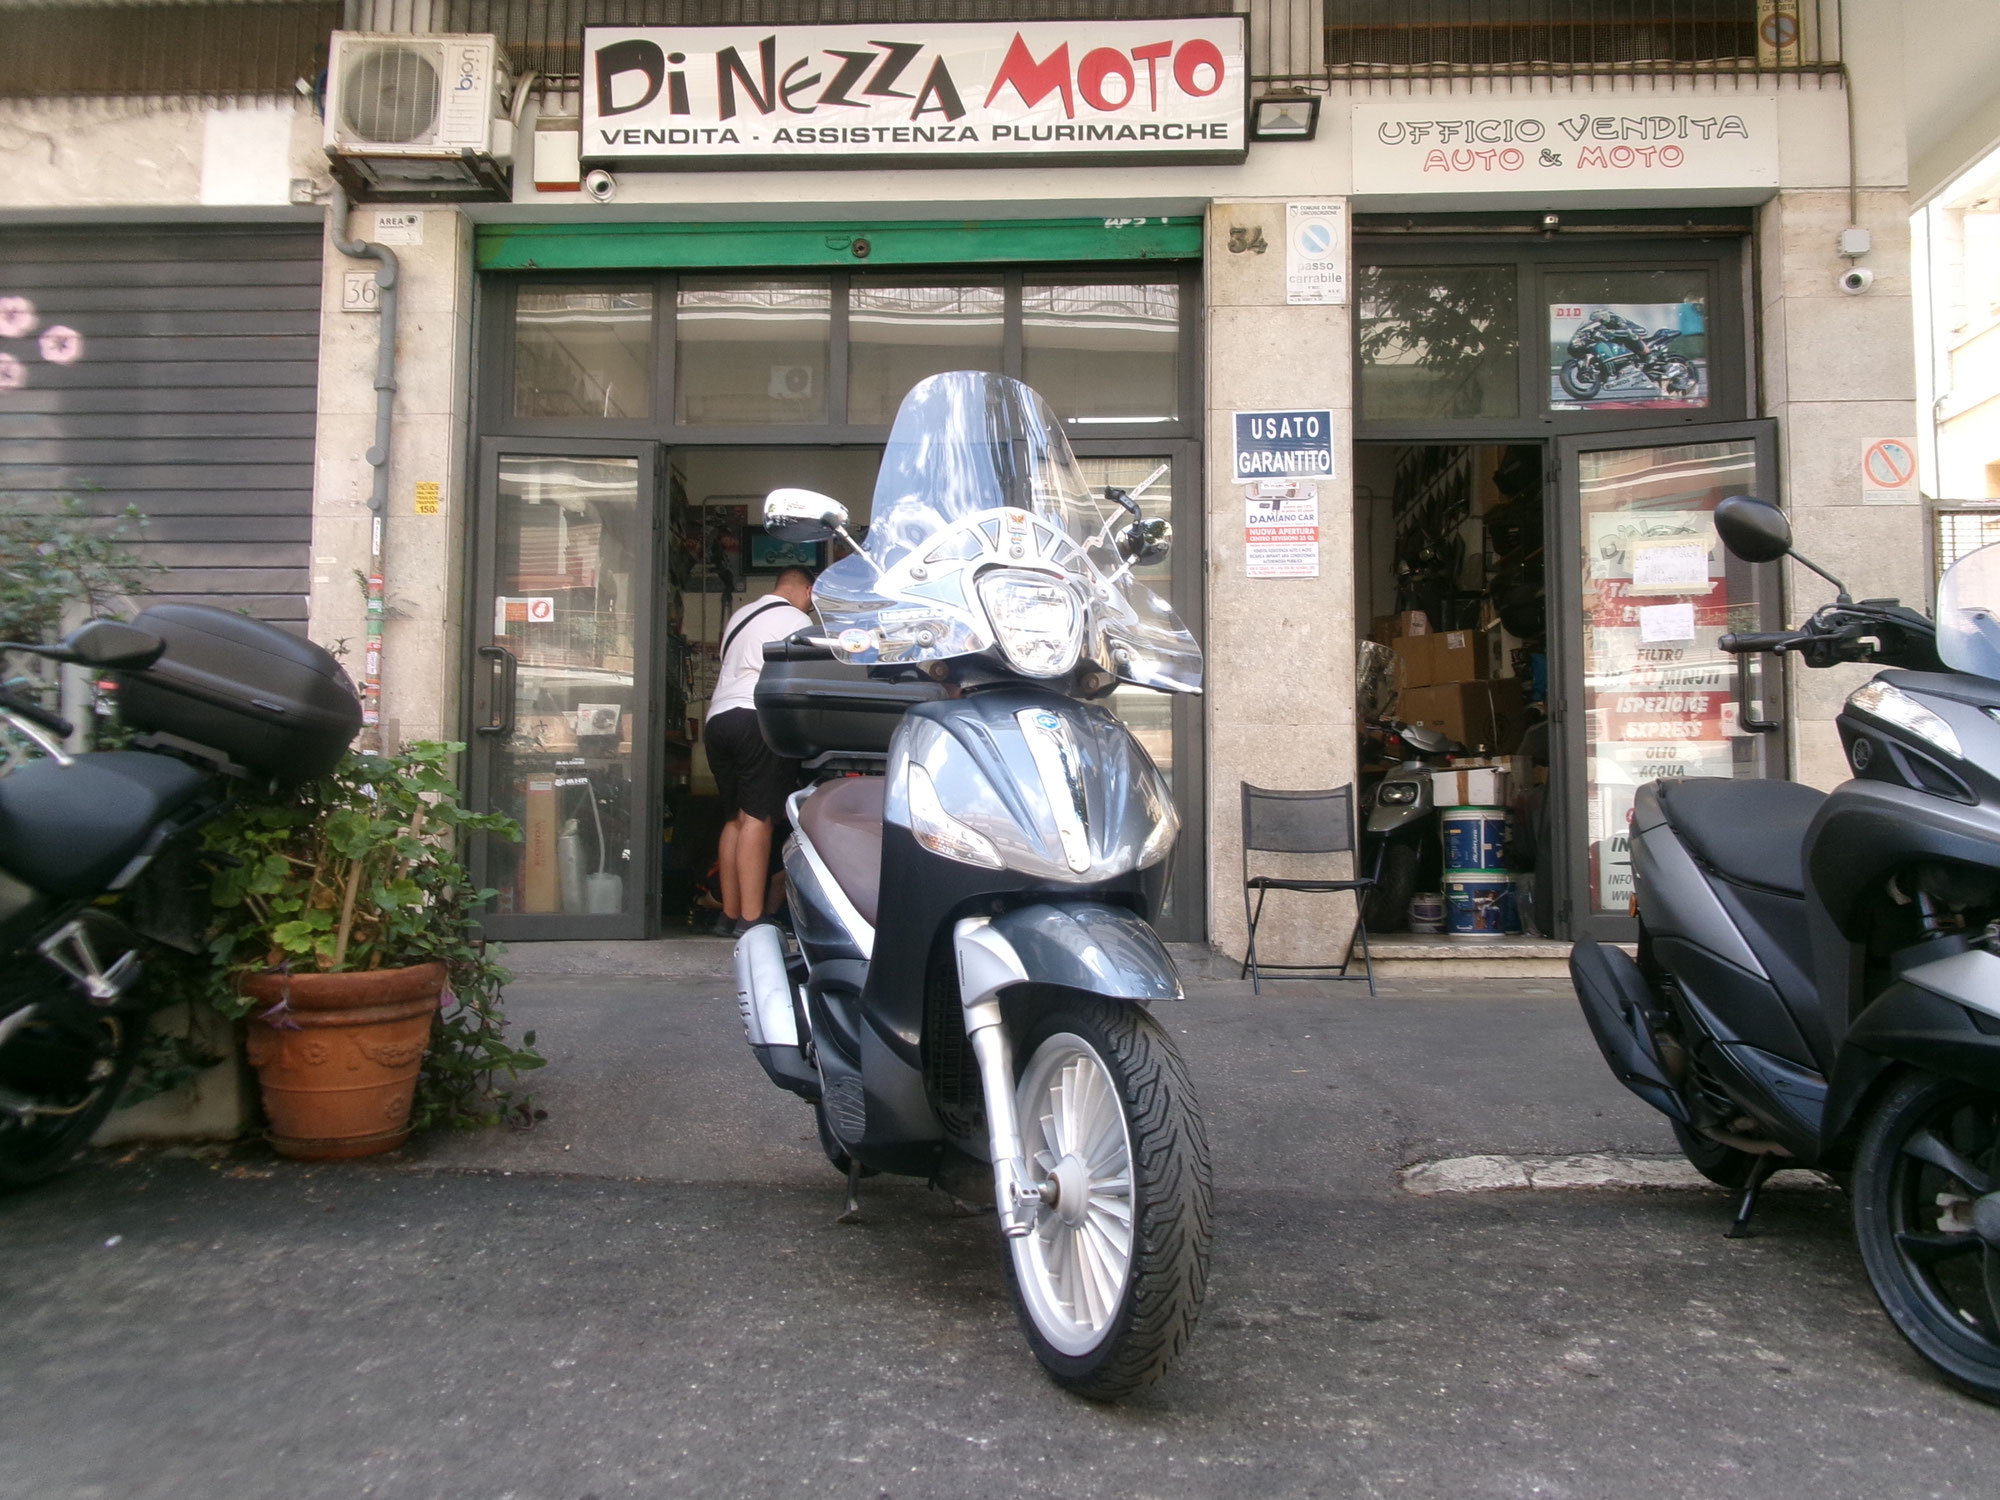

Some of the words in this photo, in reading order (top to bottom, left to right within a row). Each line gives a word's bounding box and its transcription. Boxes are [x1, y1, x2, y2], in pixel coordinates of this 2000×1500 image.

[594, 39, 691, 117] Di
[983, 31, 1225, 119] MOTO
[599, 128, 741, 145] VENDITA
[772, 126, 980, 143] ASSISTENZA
[992, 123, 1228, 141] PLURIMARCHE
[1378, 118, 1545, 145] UFFICIO
[1557, 113, 1749, 141] VENDITA
[1423, 147, 1525, 172] AUTO
[1538, 148, 1562, 168] &
[1577, 145, 1685, 169] MOTO
[1227, 227, 1268, 254] 34
[1289, 272, 1342, 283] carrabile
[345, 279, 377, 303] 36
[1556, 308, 1582, 317] DID
[1251, 416, 1319, 440] USATO
[1238, 450, 1331, 474] GARANTITO
[1249, 514, 1296, 524] DAMIANO
[1249, 528, 1277, 536] NUOVA
[1278, 527, 1315, 535] APERTURA
[1636, 648, 1684, 661] FILTRO
[1660, 669, 1721, 686] MINUTI
[1616, 696, 1710, 713] ISPEZIONE
[1626, 721, 1703, 739] EXPRESS
[1645, 746, 1677, 759] OLIO
[1638, 764, 1685, 778] ACQUA
